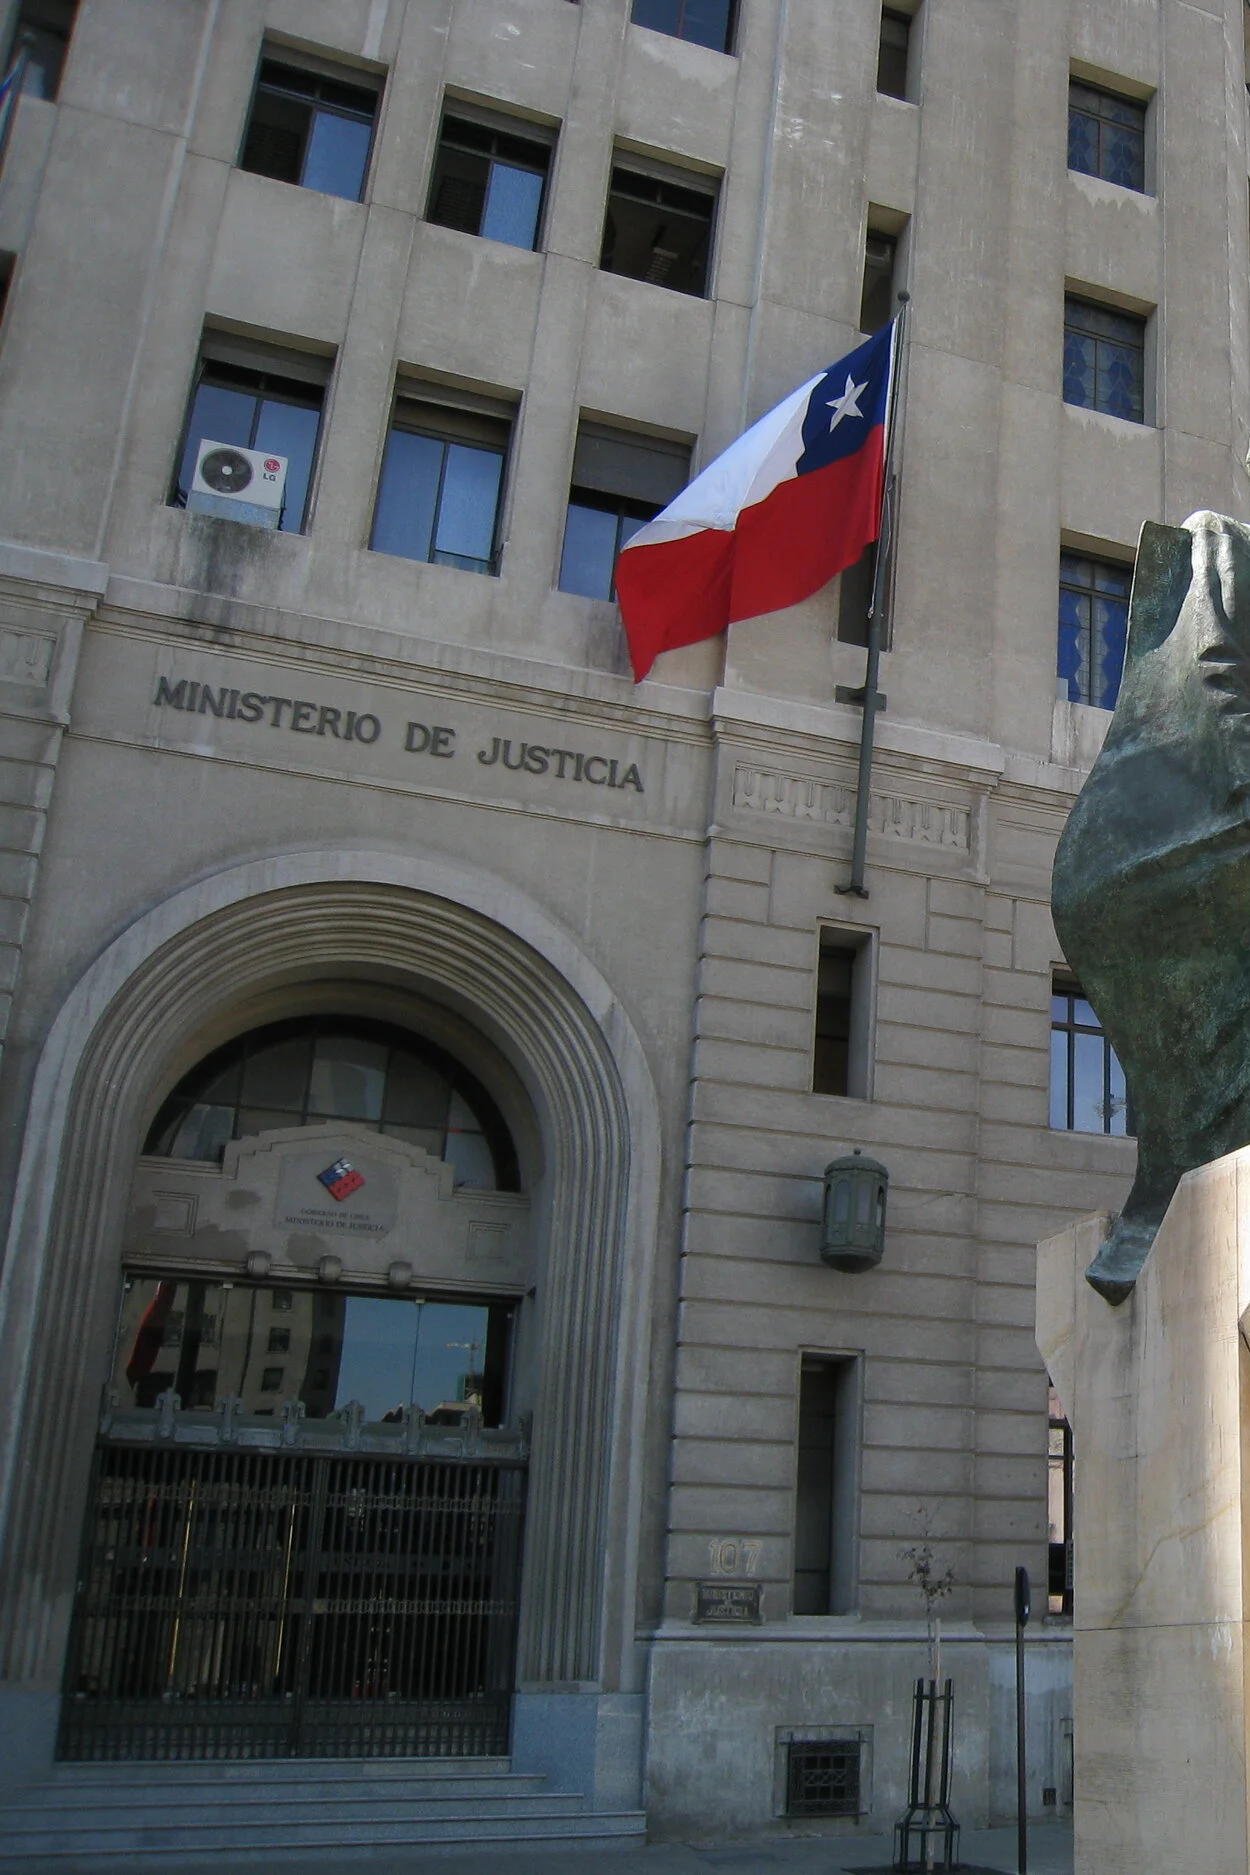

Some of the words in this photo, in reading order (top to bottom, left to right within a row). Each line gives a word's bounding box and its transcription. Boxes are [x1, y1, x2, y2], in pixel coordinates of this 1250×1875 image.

[263, 472, 276, 482] LG
[153, 675, 381, 743] MINISTERIO
[404, 721, 456, 758] DE
[477, 737, 644, 793] JUSTICIA
[708, 1540, 763, 1577] 107
